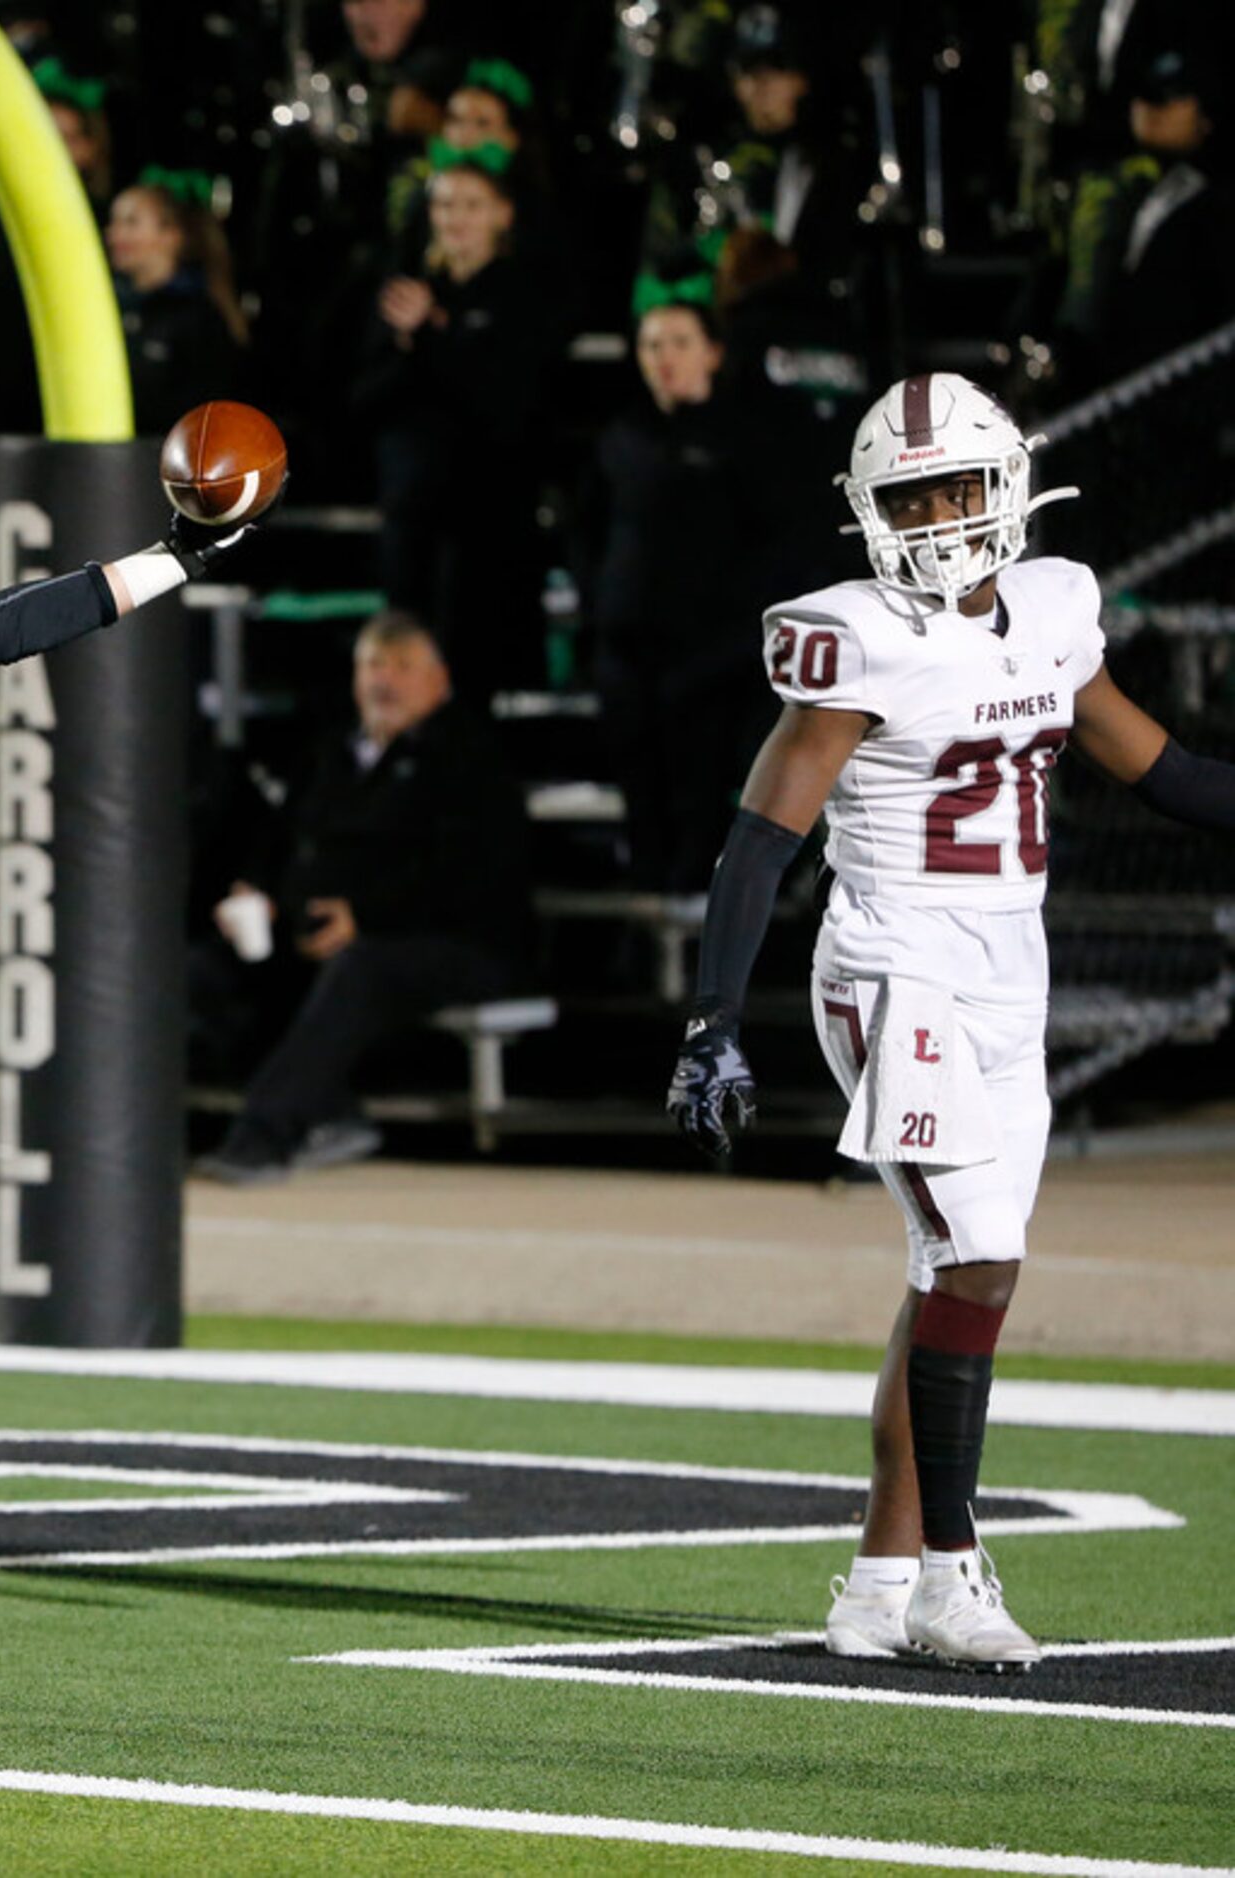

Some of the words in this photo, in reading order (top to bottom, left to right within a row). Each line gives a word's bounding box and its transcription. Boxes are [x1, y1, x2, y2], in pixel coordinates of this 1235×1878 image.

[772, 626, 839, 690] 20
[974, 692, 1057, 724] FARMERS
[922, 728, 1070, 875] 20
[914, 1029, 941, 1063] L
[899, 1112, 936, 1148] 20
